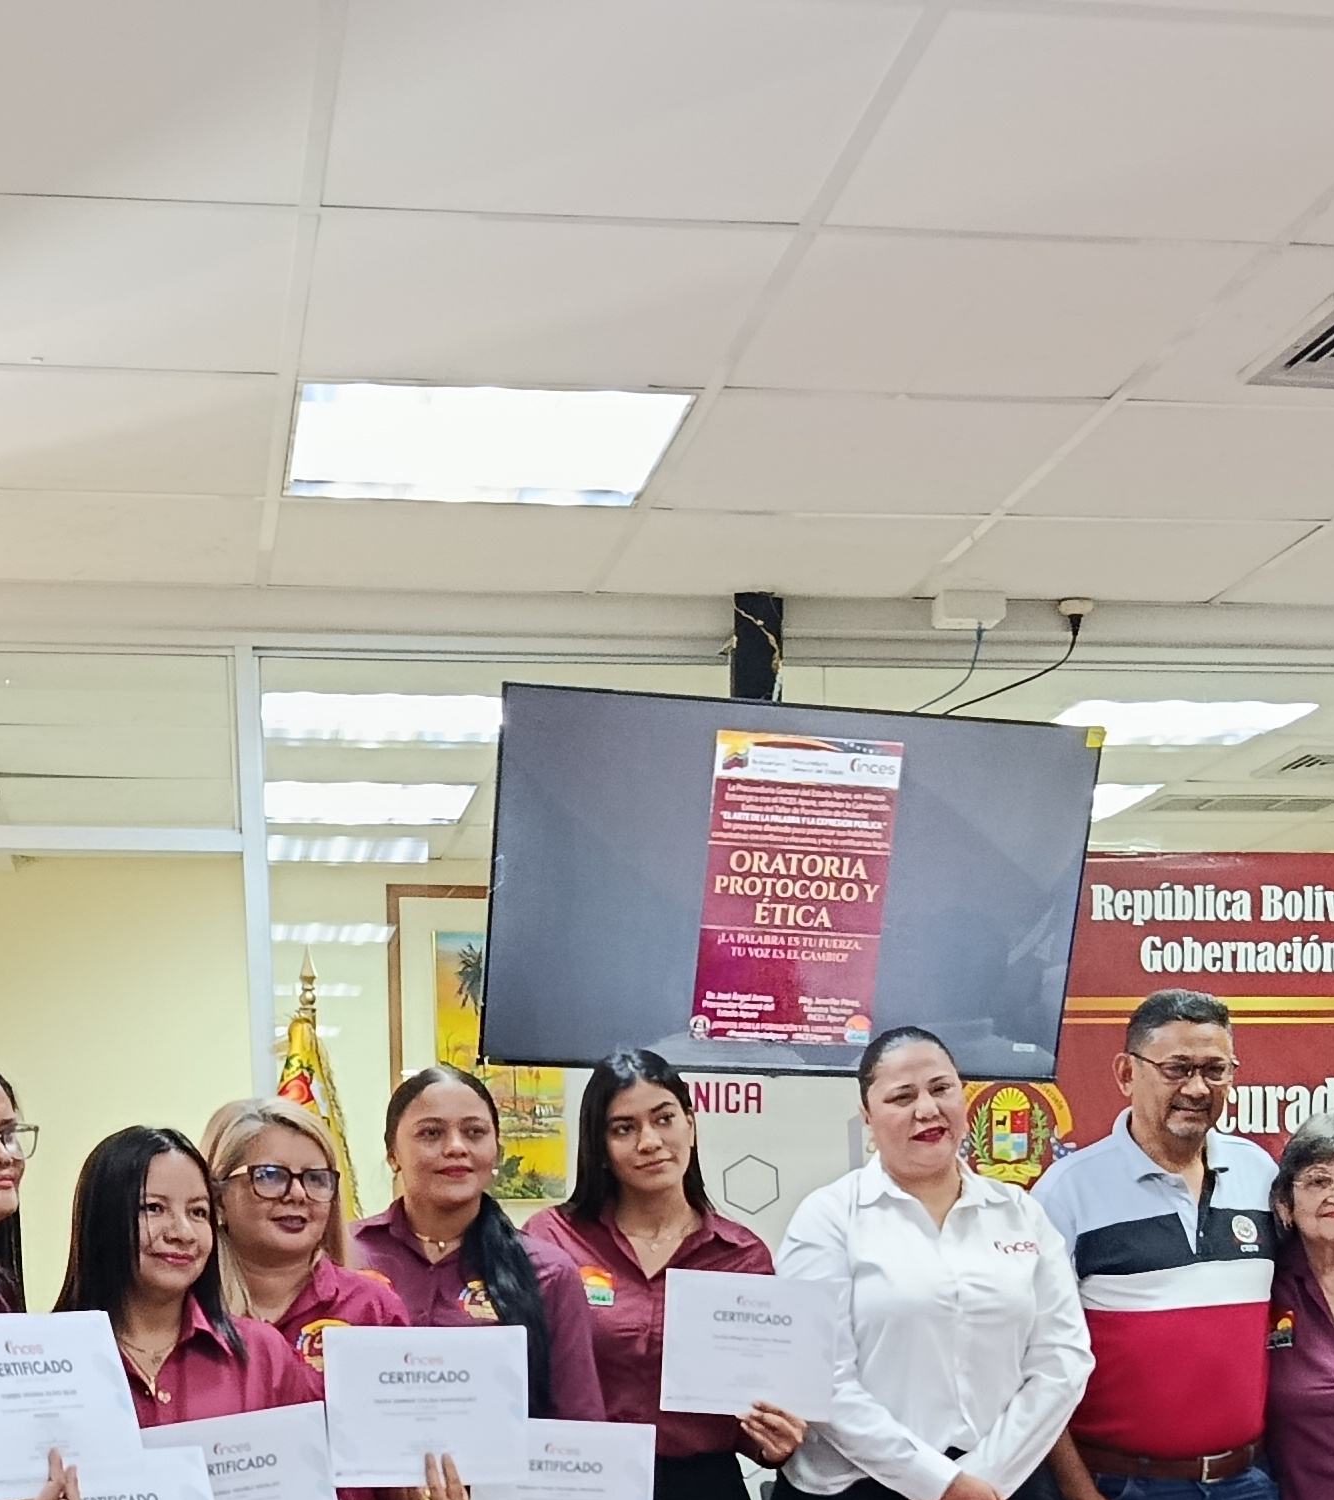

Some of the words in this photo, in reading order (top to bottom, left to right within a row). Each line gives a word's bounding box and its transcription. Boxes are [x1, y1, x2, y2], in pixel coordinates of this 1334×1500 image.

[850, 757, 896, 775] inces
[729, 850, 868, 880] ORATORIA
[714, 875, 859, 901] PROTOCOLO
[863, 883, 880, 903] Y
[754, 898, 832, 928] ÉTICA
[1091, 882, 1252, 926] República
[736, 934, 785, 946] PALABRA
[787, 936, 800, 947] ES
[802, 936, 816, 947] TU
[731, 946, 746, 957] TU
[748, 948, 769, 959] VOZ
[772, 949, 785, 959] ES
[787, 949, 799, 960] EL
[685, 1082, 762, 1114] NICA
[713, 1309, 793, 1326] CERTIFICADO
[378, 1369, 471, 1385] CERTIFICADO
[207, 1453, 278, 1476] RTIFICADO
[528, 1459, 604, 1474] ERTIFICADO
